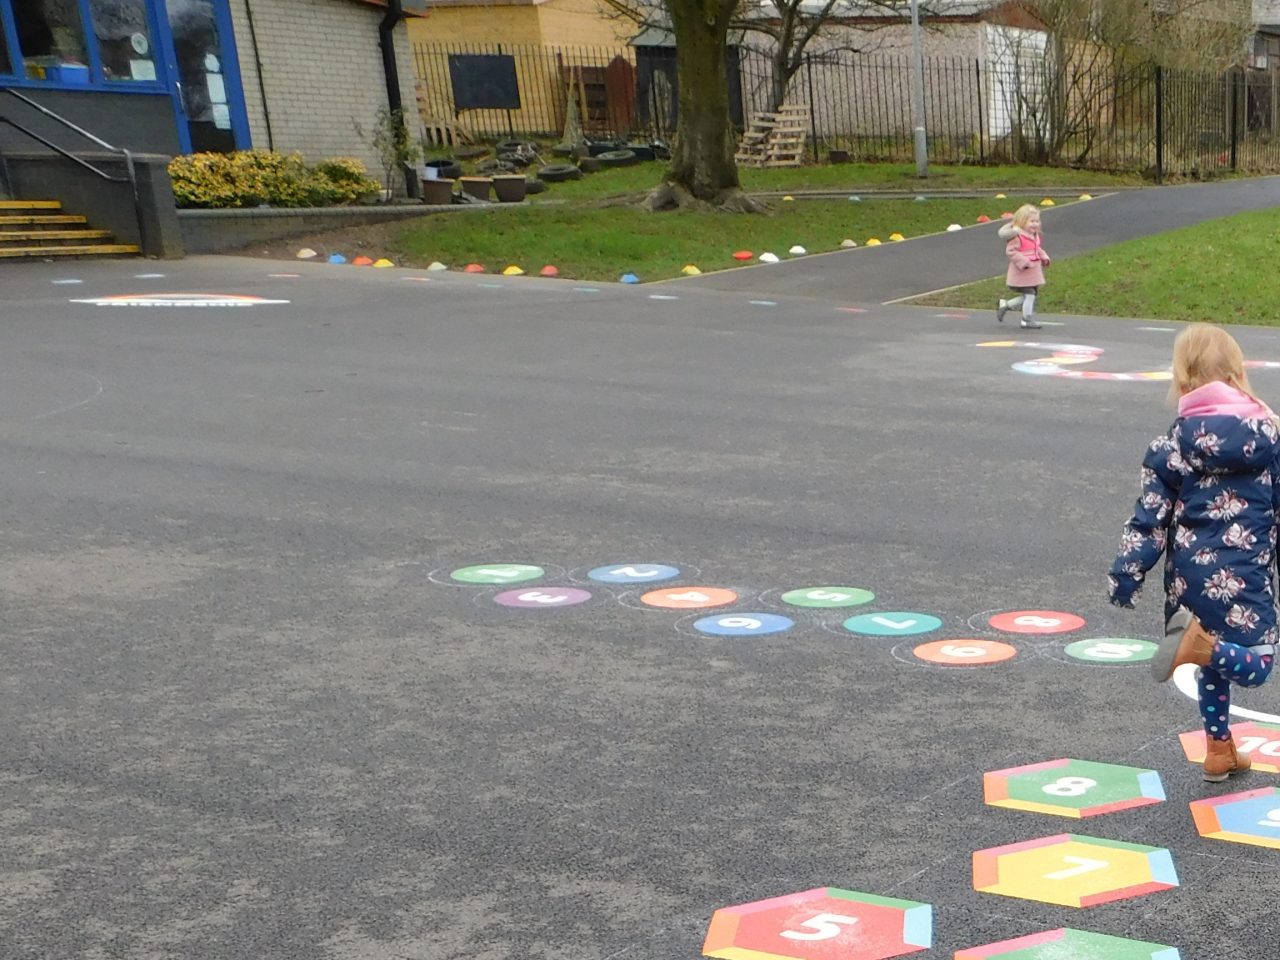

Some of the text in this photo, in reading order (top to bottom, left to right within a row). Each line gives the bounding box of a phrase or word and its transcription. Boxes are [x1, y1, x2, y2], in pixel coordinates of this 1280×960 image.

[517, 591, 568, 603] 3
[806, 589, 851, 602] 5
[871, 616, 917, 630] 7
[1014, 615, 1062, 628] 8
[1041, 776, 1097, 797] 8
[1044, 855, 1109, 880] 7
[779, 912, 860, 941] 5
